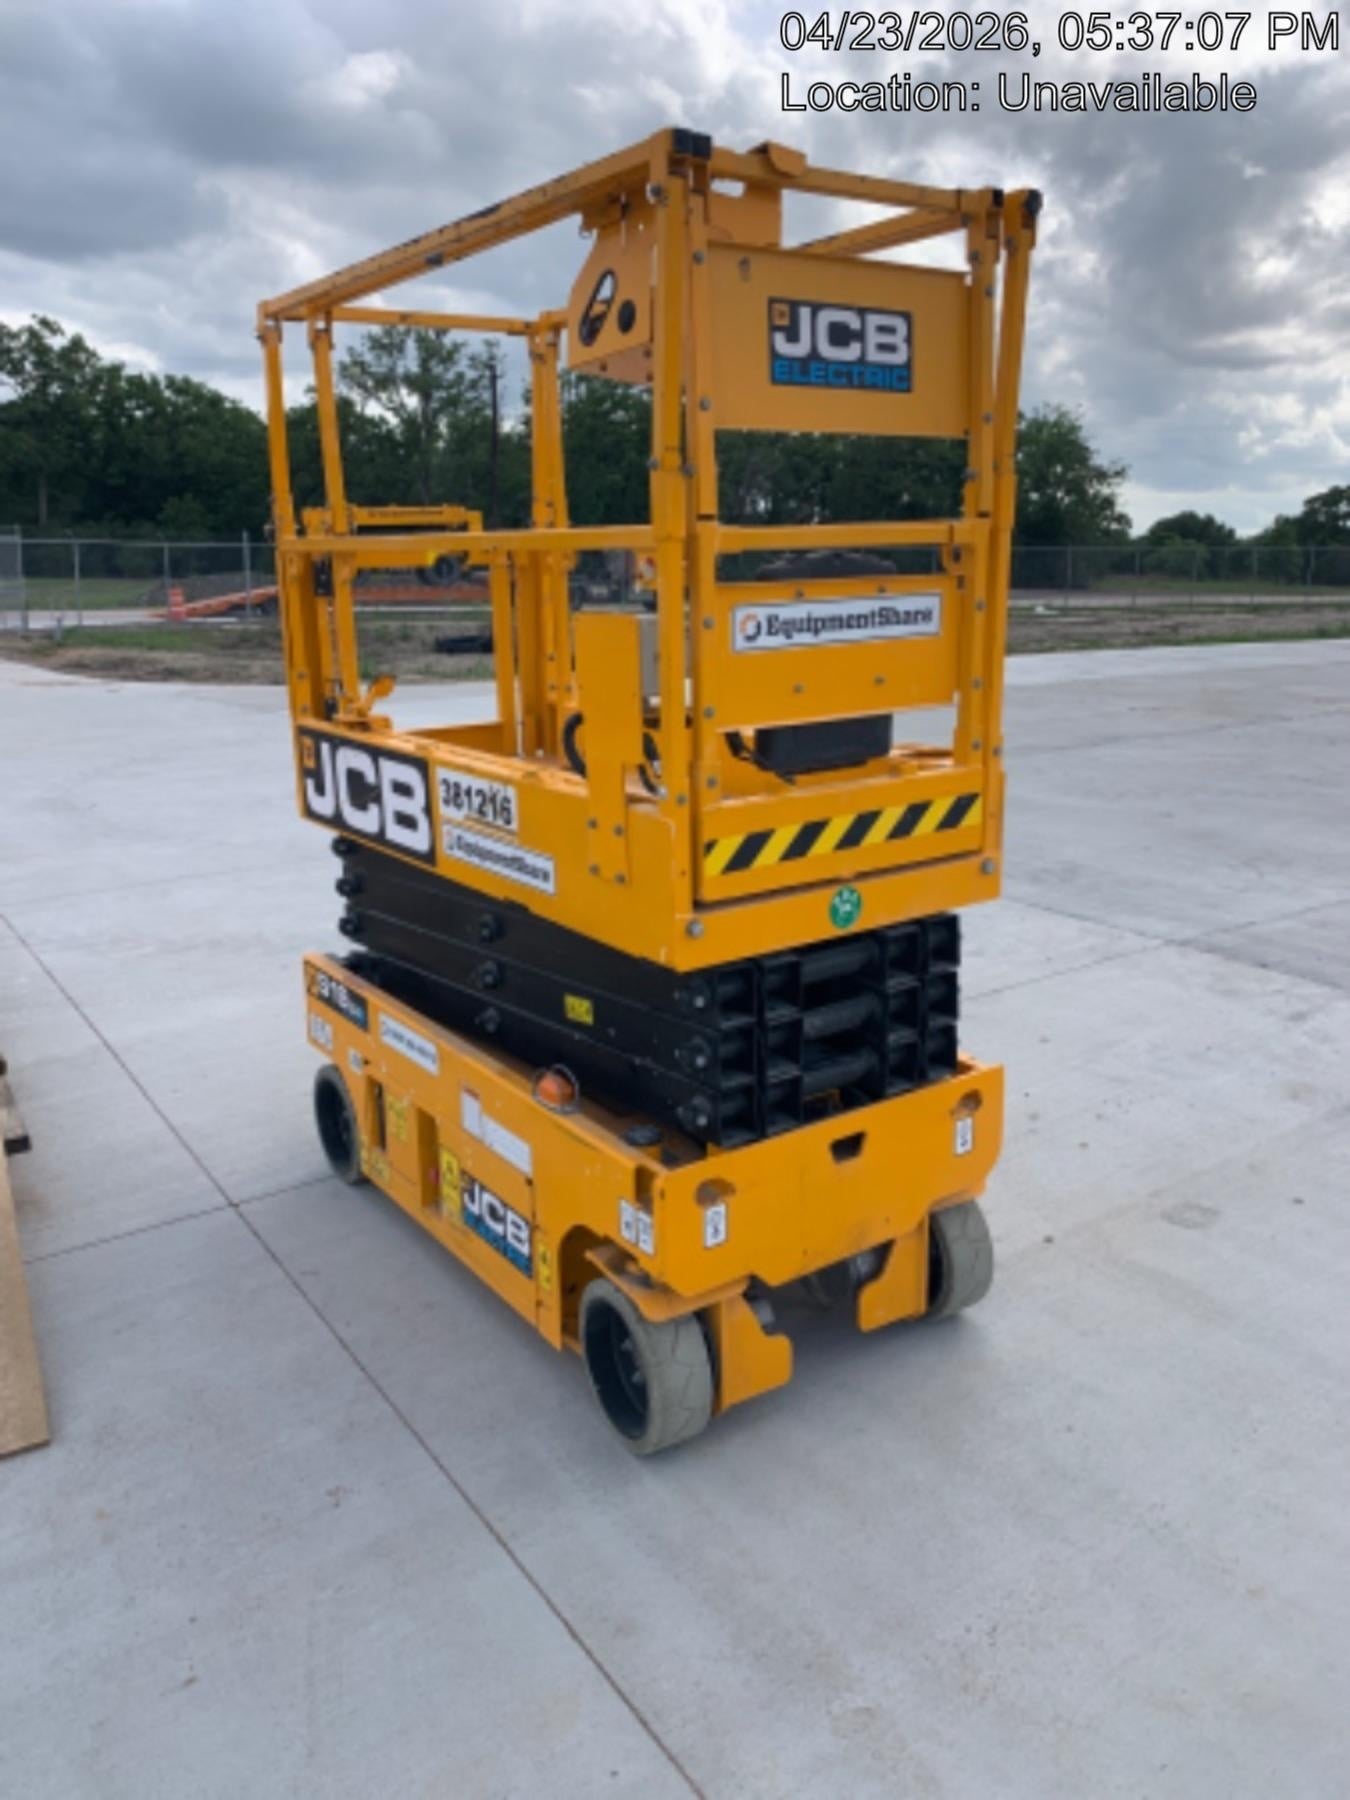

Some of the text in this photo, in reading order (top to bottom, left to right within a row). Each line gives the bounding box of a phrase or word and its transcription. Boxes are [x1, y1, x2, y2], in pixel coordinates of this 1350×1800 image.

[773, 305, 909, 366] JCB
[774, 360, 910, 391] ELECTRIC
[765, 606, 934, 640] EquipmentShare
[305, 740, 433, 855] JCB
[463, 1182, 530, 1258] JCB
